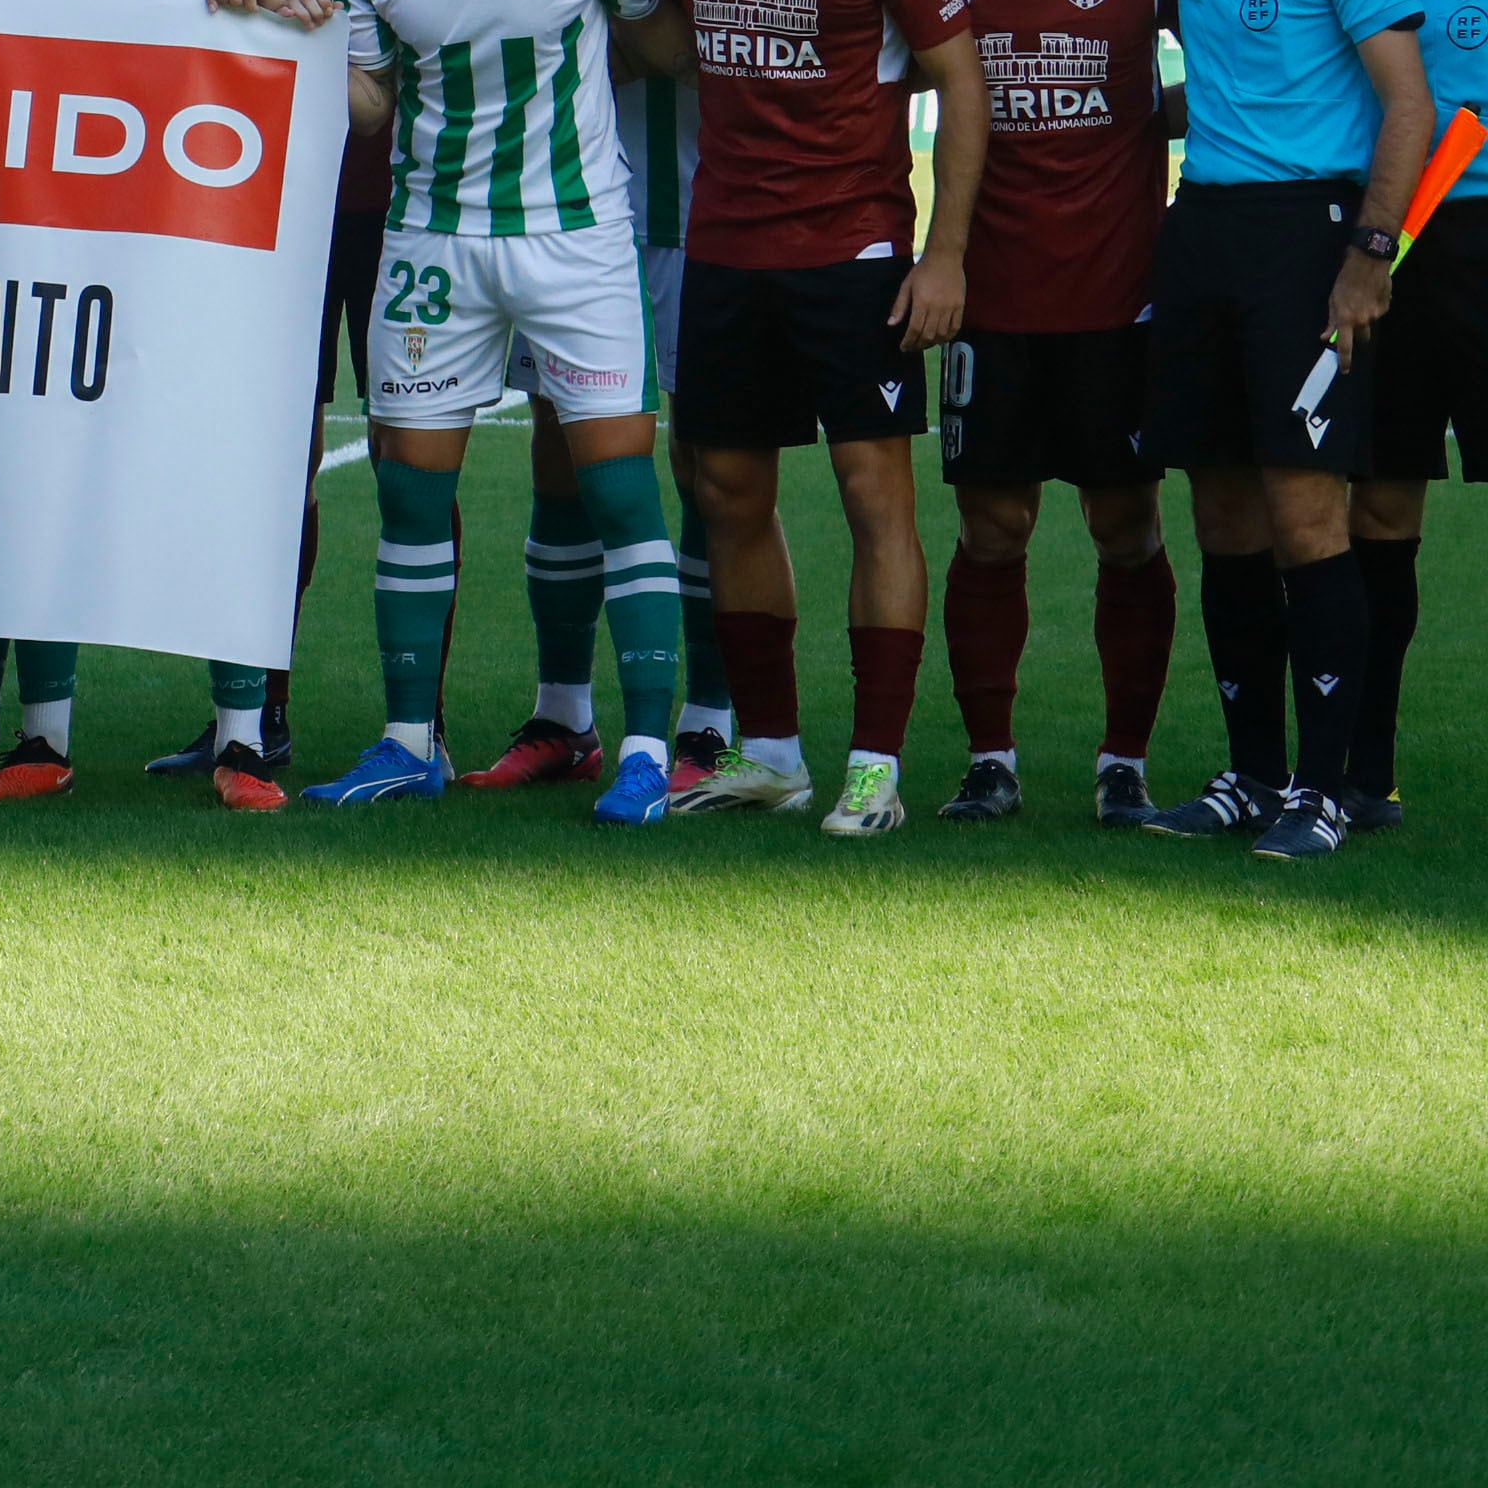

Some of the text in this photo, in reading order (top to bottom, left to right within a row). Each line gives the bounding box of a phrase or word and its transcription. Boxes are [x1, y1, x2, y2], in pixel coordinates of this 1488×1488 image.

[695, 29, 822, 68] MÉRIDA
[762, 68, 826, 80] HUMANIDAD
[990, 85, 1109, 120] ÉRIDA
[1017, 121, 1031, 132] DE
[1032, 120, 1047, 132] LA
[1047, 115, 1112, 131] HUMANIDAD
[383, 259, 452, 326] 23
[381, 377, 459, 394] GIVOVA
[565, 369, 629, 389] iFertility
